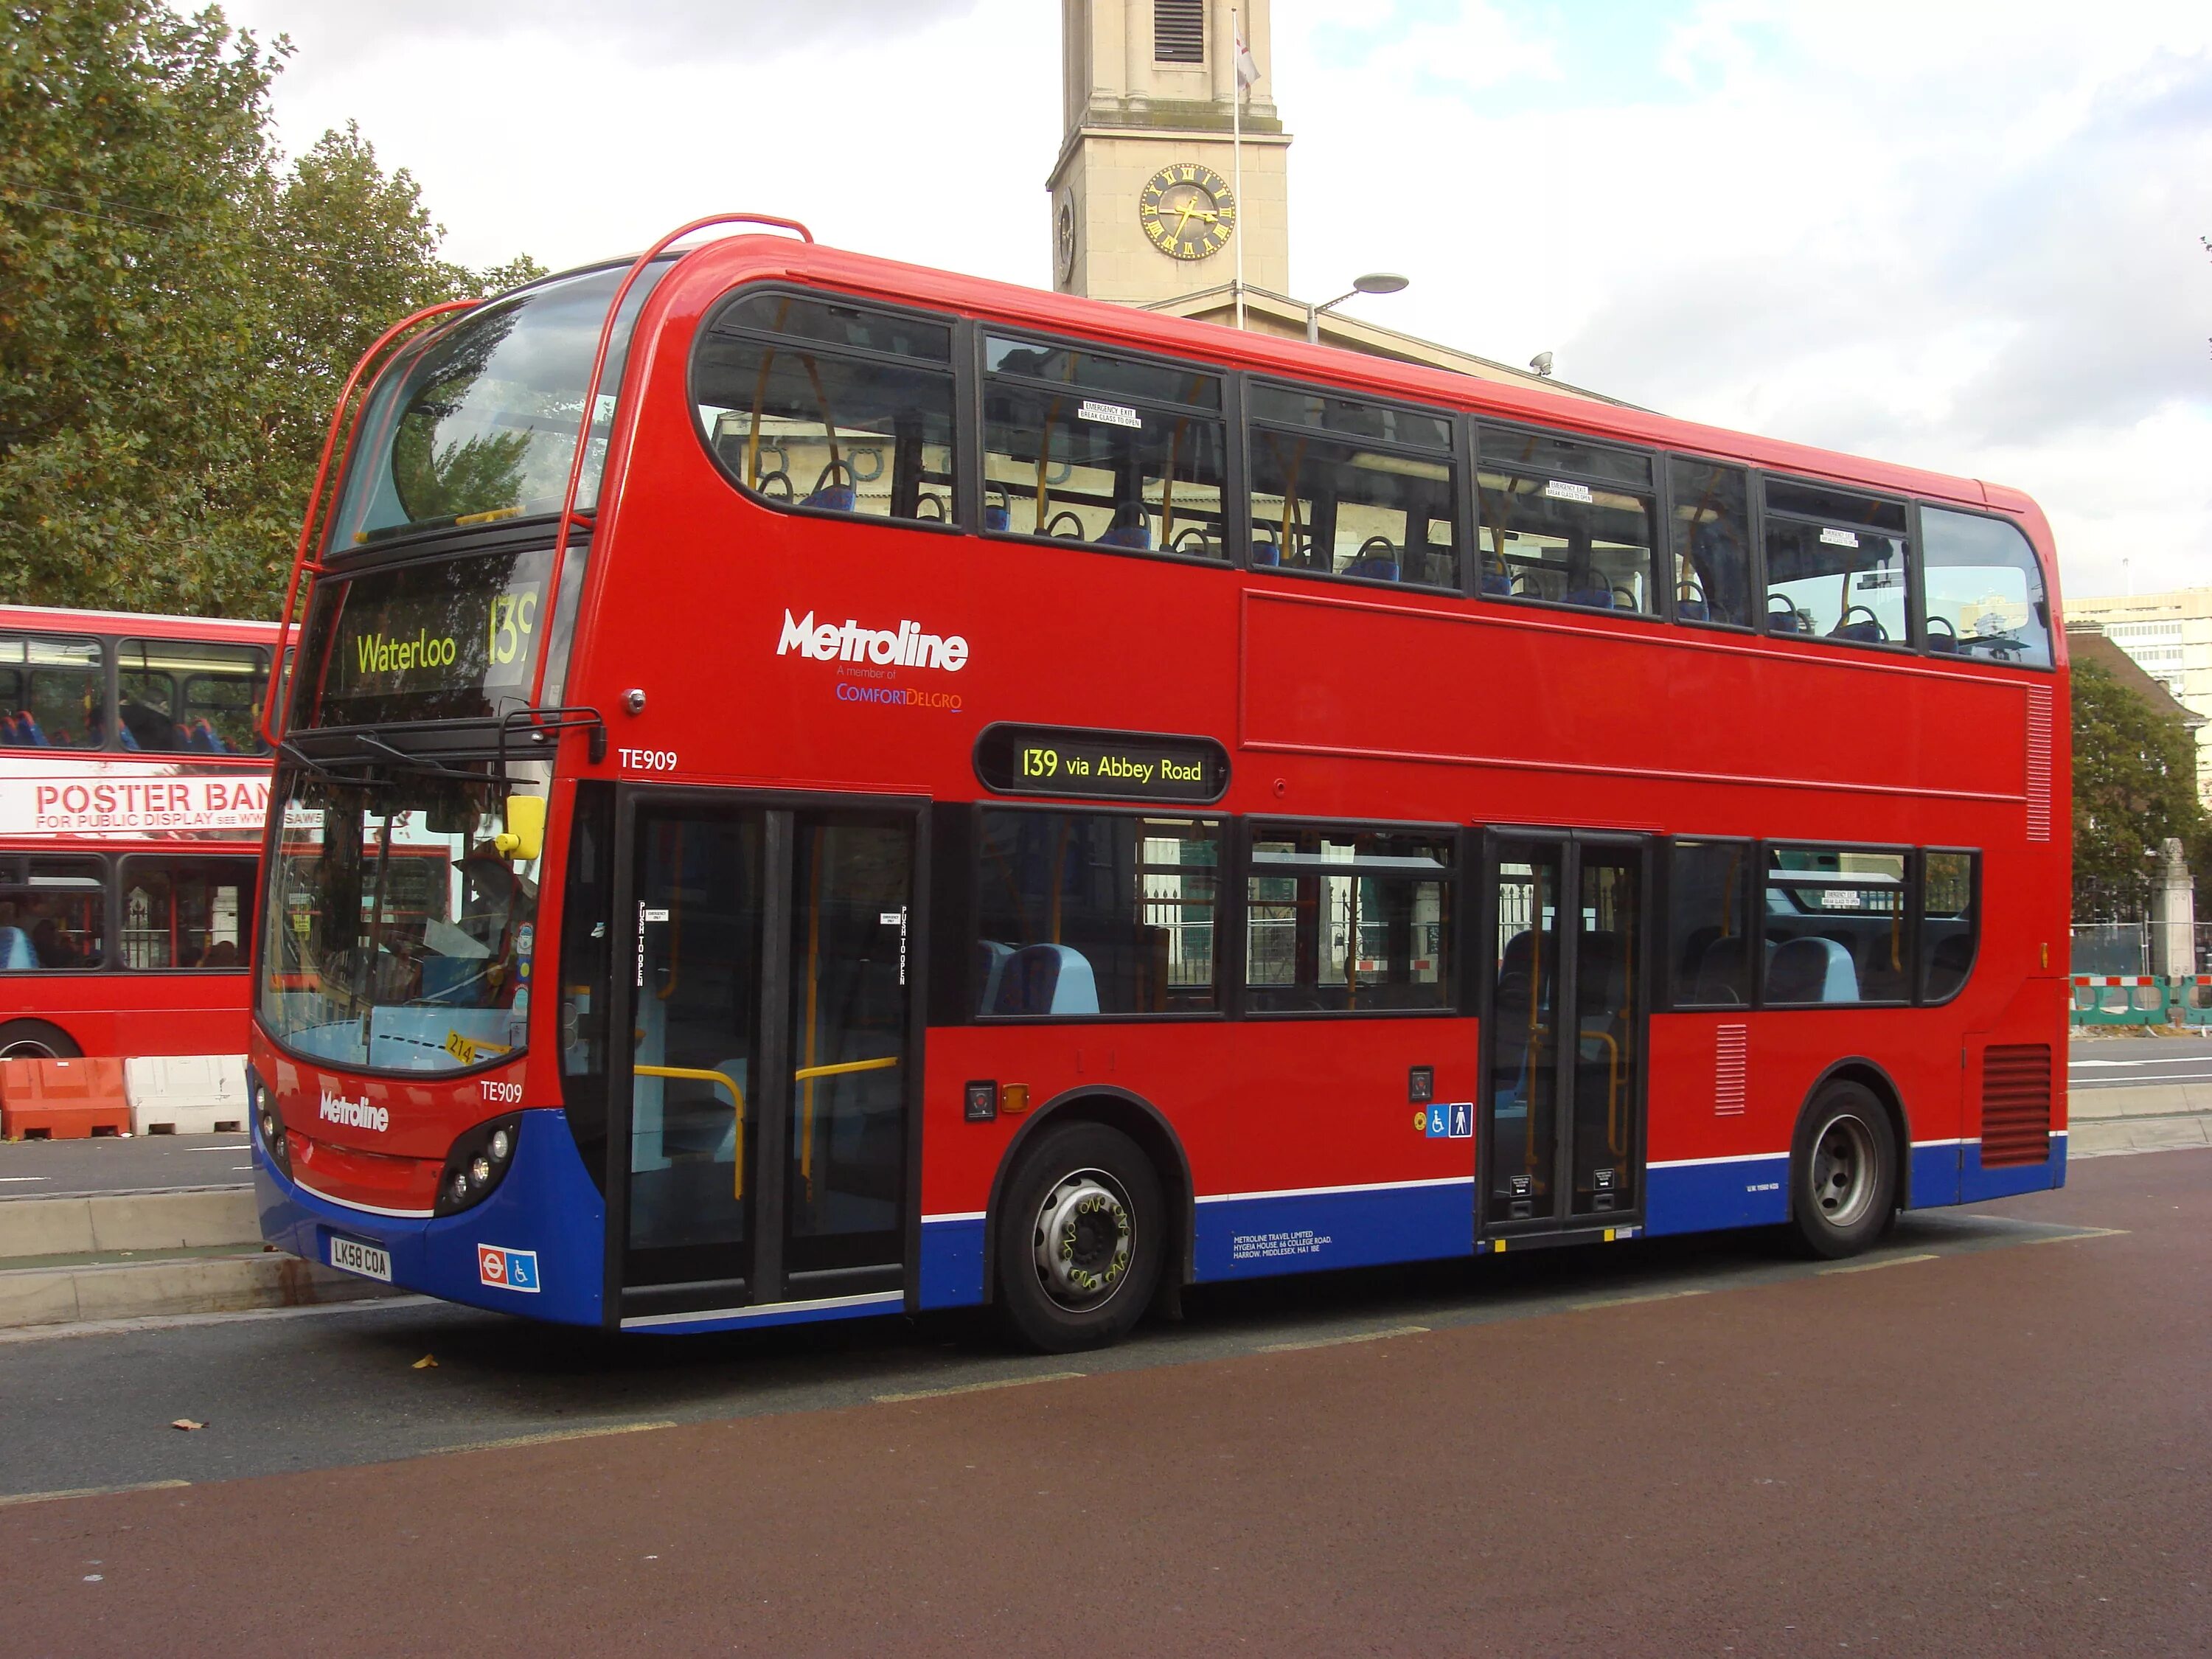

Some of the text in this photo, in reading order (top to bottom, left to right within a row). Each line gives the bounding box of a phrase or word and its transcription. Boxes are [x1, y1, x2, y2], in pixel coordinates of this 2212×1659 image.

[1081, 411, 1098, 420] BREAK
[1125, 418, 1139, 426] OPEN
[1085, 403, 1133, 417] EMERGENCY EXIT
[776, 608, 969, 671] Metroline
[357, 628, 456, 674] Waterloo
[837, 666, 897, 680] A member of
[618, 748, 677, 771] TE909
[1023, 749, 1201, 783] 139 via Abbey Road
[37, 785, 191, 813] POSTER
[37, 815, 72, 828] FOR
[77, 814, 139, 827] PUBLIC
[145, 813, 214, 826] DISPLAY
[217, 816, 236, 824] SEE
[639, 936, 644, 953] TO
[901, 938, 905, 953] TO
[450, 1034, 472, 1062] 214
[481, 1081, 522, 1103] TE909
[320, 1089, 389, 1133] Metroline
[1234, 1231, 1312, 1243] METROLINE TRAVEL LIMITED
[1234, 1243, 1255, 1252] HYGEIA
[1287, 1238, 1313, 1247] COLLEGE
[335, 1240, 386, 1275] LK58 COA
